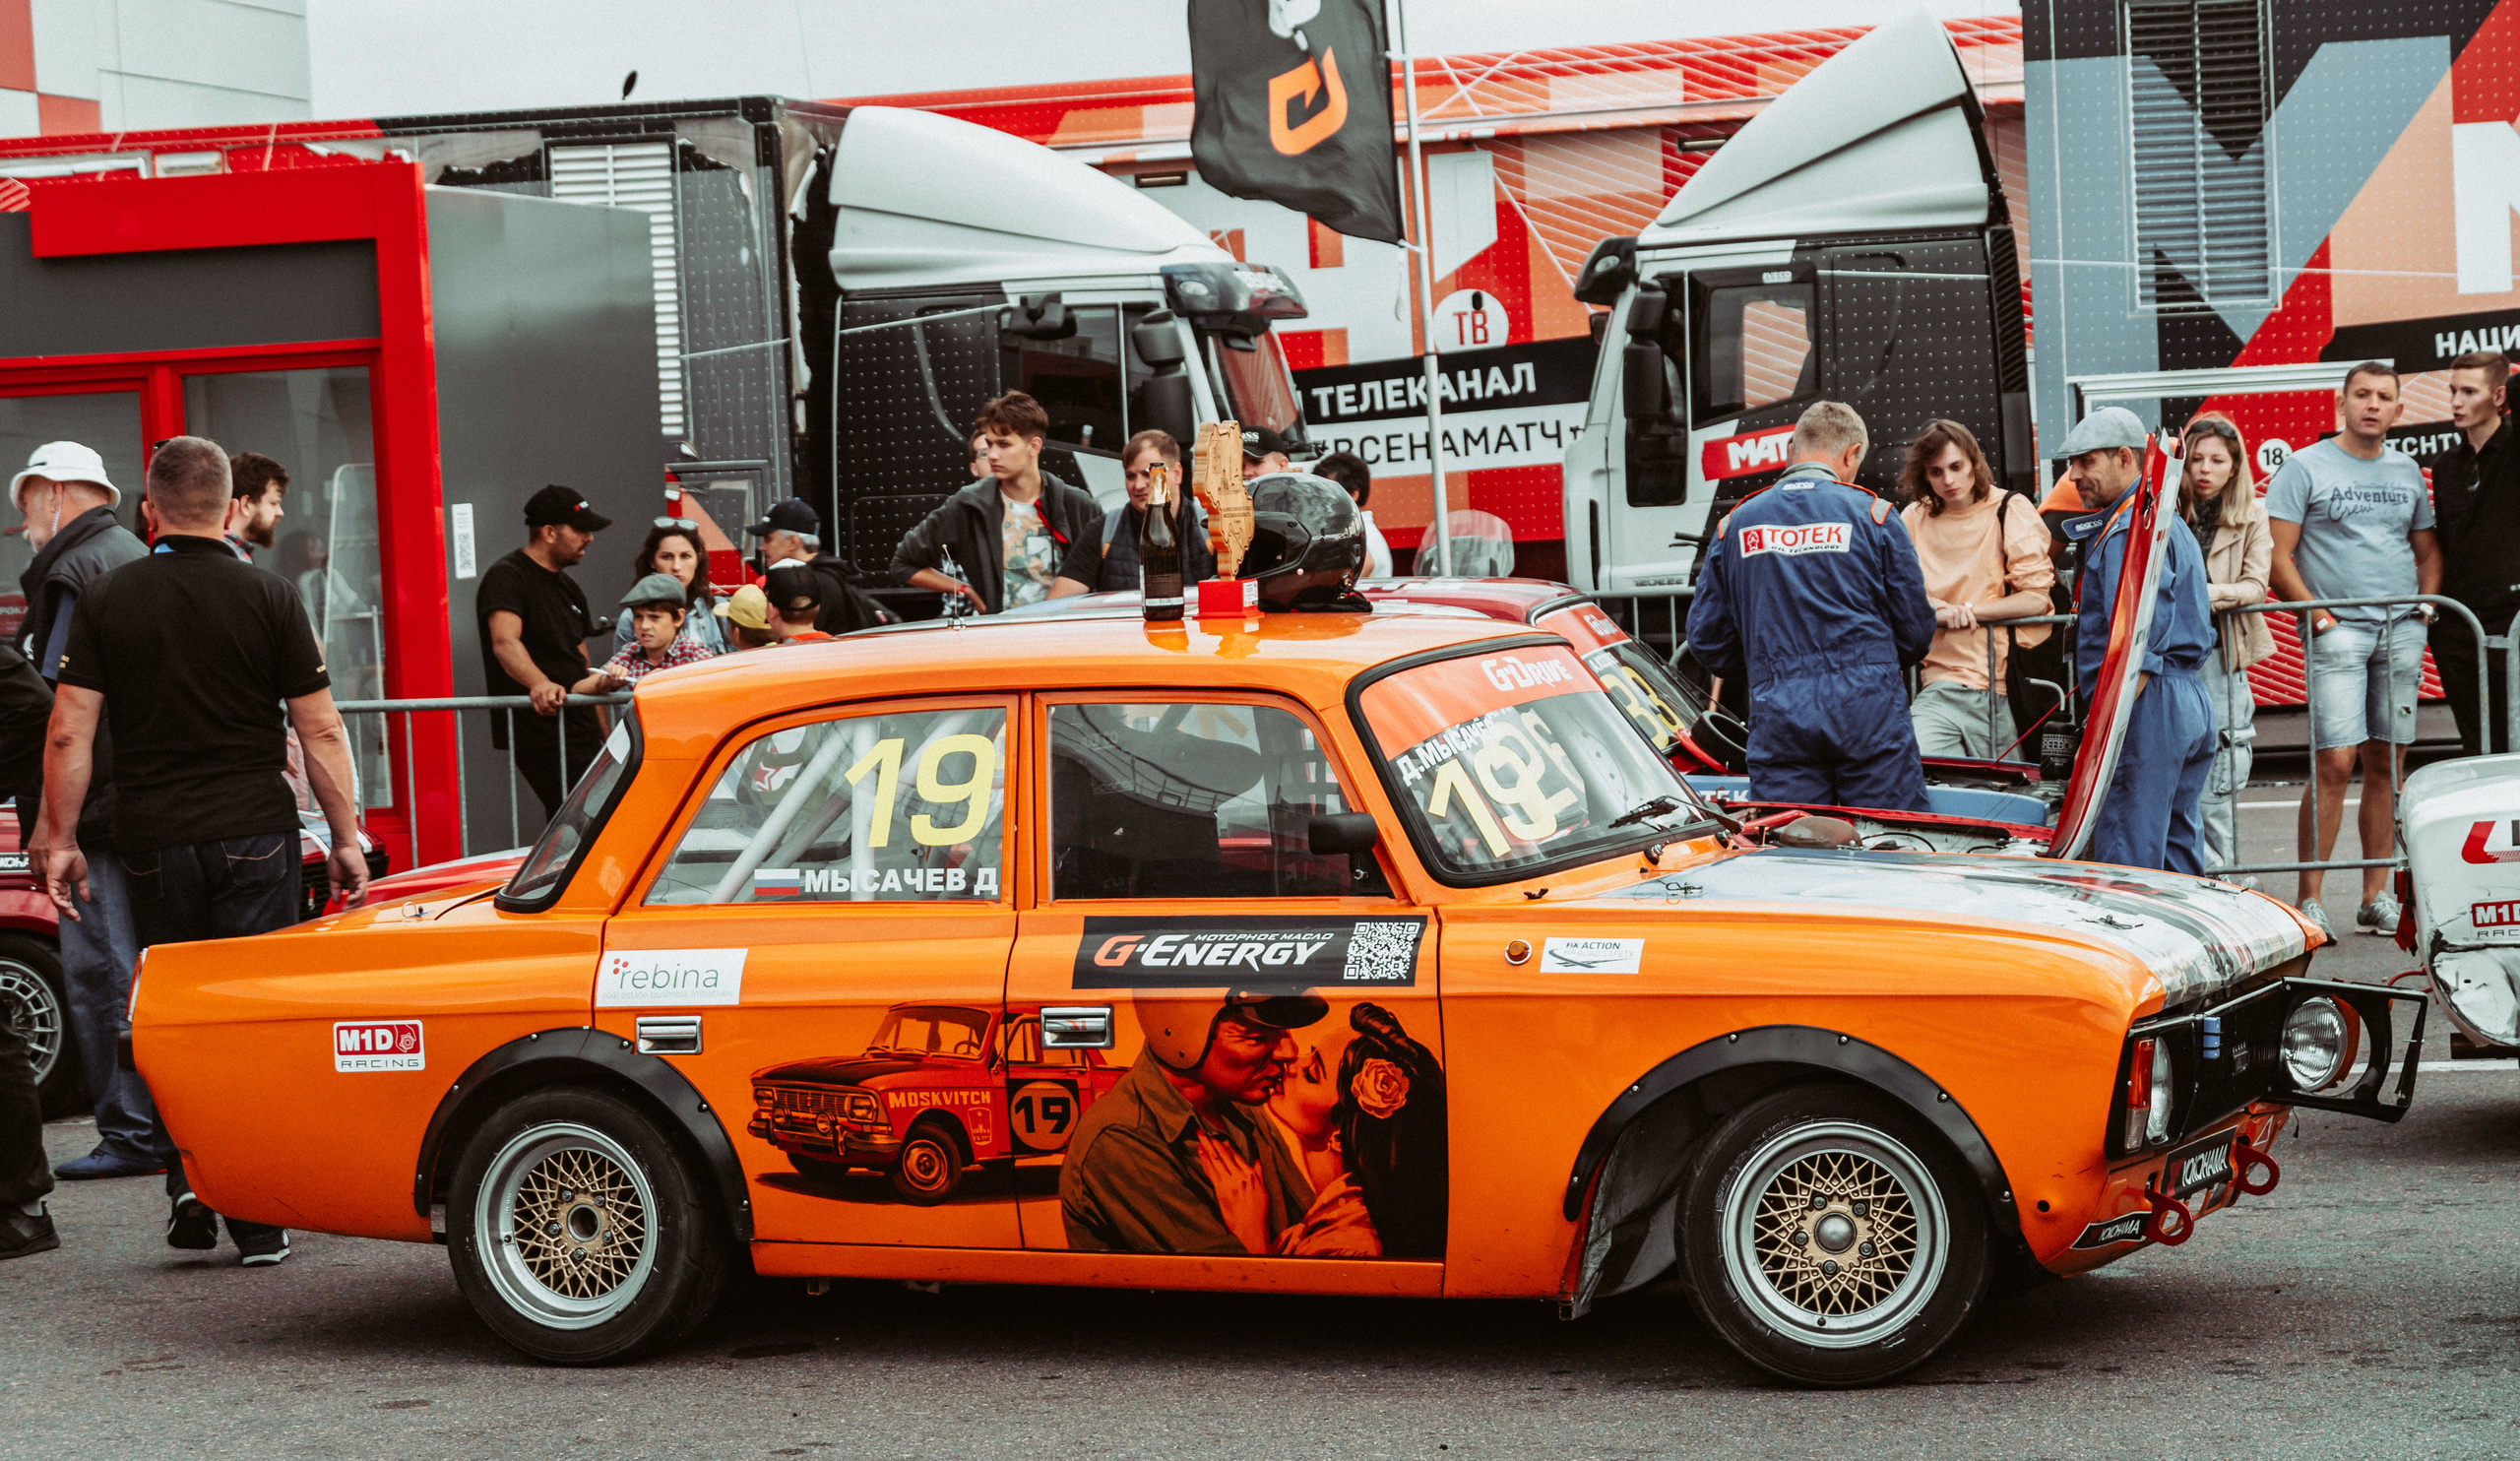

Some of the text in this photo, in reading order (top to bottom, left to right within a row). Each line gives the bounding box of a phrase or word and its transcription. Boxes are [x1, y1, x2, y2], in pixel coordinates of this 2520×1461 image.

[1453, 310, 1489, 346] ТВ
[1311, 361, 1537, 417] ТЕЛЕКАНАЛ
[1727, 433, 1788, 471] МАТ
[2330, 486, 2409, 505] Adventure
[1767, 526, 1844, 547] TOTEK
[844, 733, 996, 849] 19
[804, 867, 998, 895] МЫСАЧЕВ Д
[1193, 932, 1335, 942] МОТОРНОЕ МАСЛО
[619, 963, 720, 989] rebina
[602, 989, 734, 999] real estate business initiatives
[339, 1029, 394, 1051] M1D
[341, 1058, 419, 1068] RACING
[888, 1090, 991, 1109] MOSKVITCH
[1014, 1095, 1071, 1134] 19
[2181, 1143, 2228, 1186] YOKOHAMA
[2098, 1219, 2140, 1241] YOKOHAMA
